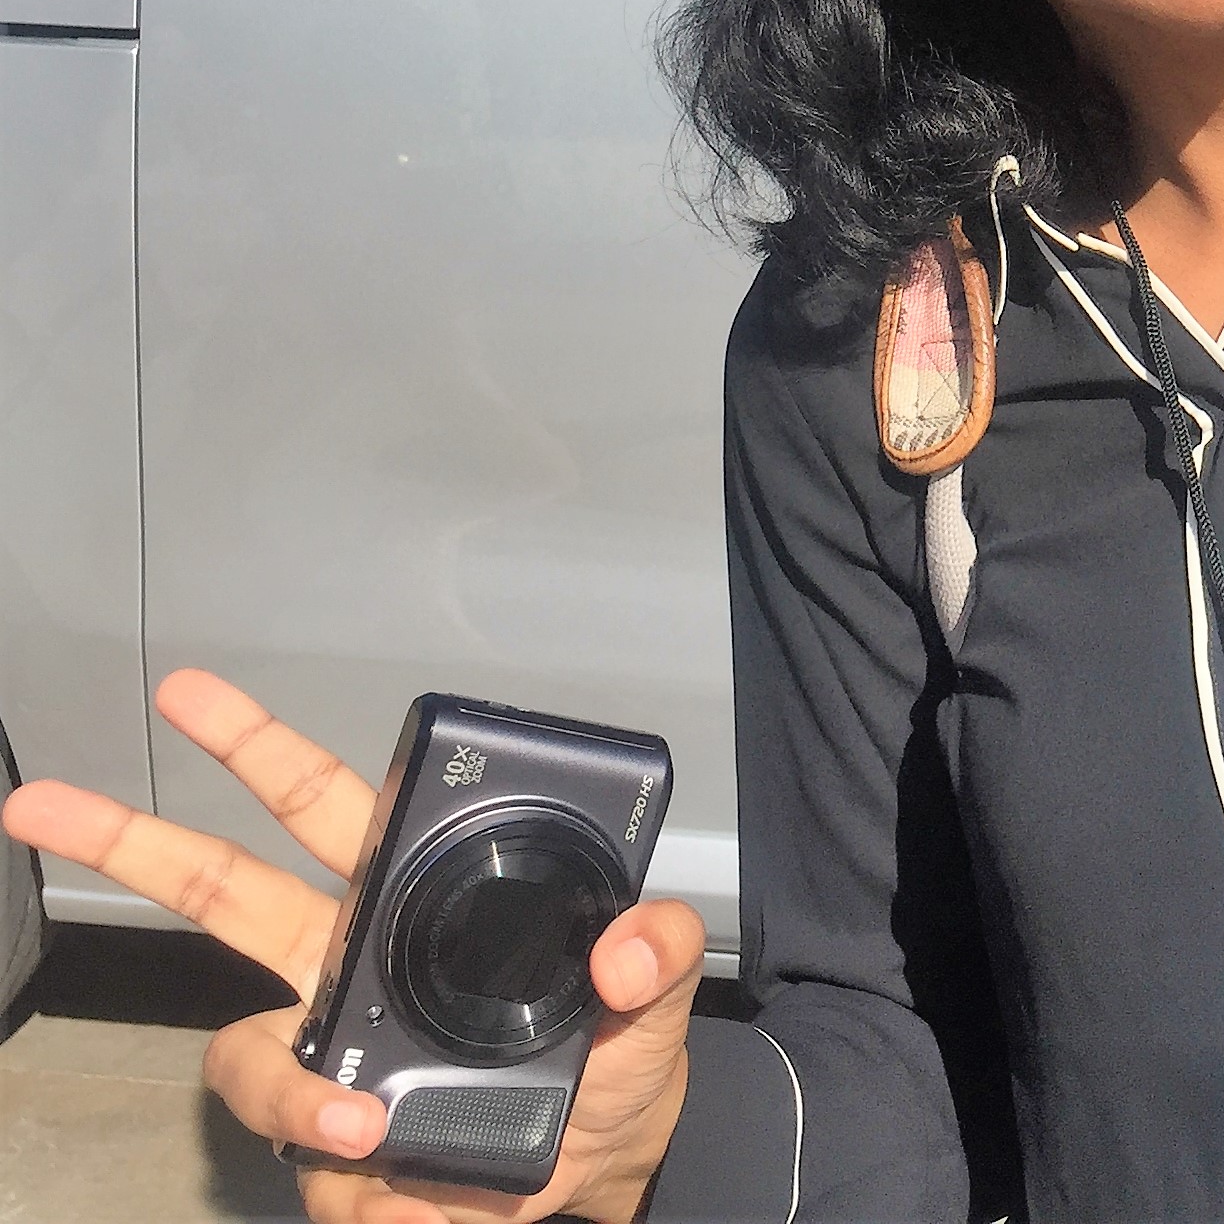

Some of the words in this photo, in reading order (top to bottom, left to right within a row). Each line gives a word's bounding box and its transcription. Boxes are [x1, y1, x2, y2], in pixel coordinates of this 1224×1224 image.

[461, 751, 480, 786] OPTICAL
[472, 755, 488, 784] ZOOM
[625, 796, 647, 844] SX720
[640, 774, 654, 798] HS
